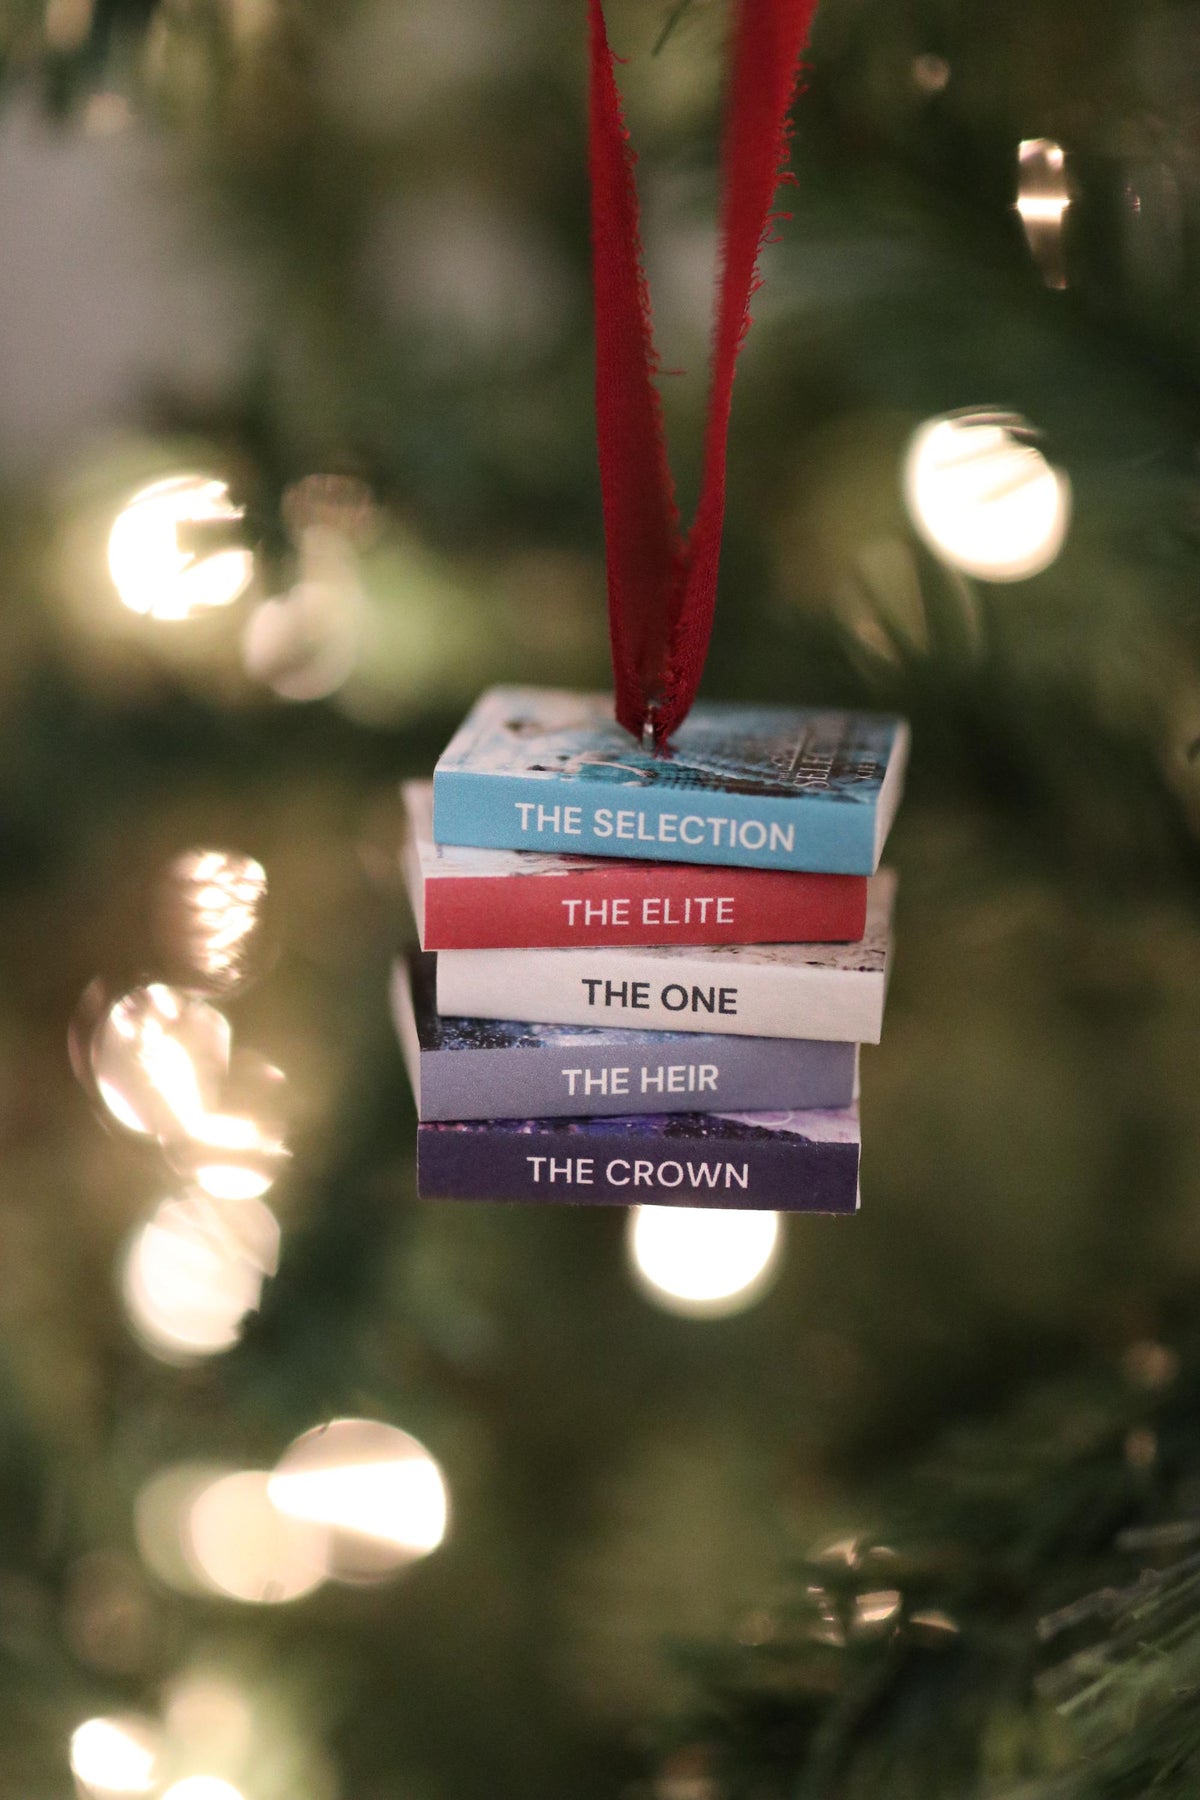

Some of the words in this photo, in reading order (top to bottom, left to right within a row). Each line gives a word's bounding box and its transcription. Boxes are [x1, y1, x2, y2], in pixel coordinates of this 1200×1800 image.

[514, 802, 583, 835] THE
[593, 808, 794, 852] SELECTION
[561, 898, 631, 926] THE
[642, 897, 735, 925] ELITE
[581, 978, 651, 1010] THE
[660, 983, 738, 1015] ONE
[561, 1067, 630, 1096] THE
[640, 1064, 719, 1093] HEIR
[526, 1156, 594, 1184] THE
[605, 1159, 749, 1189] CROWN
